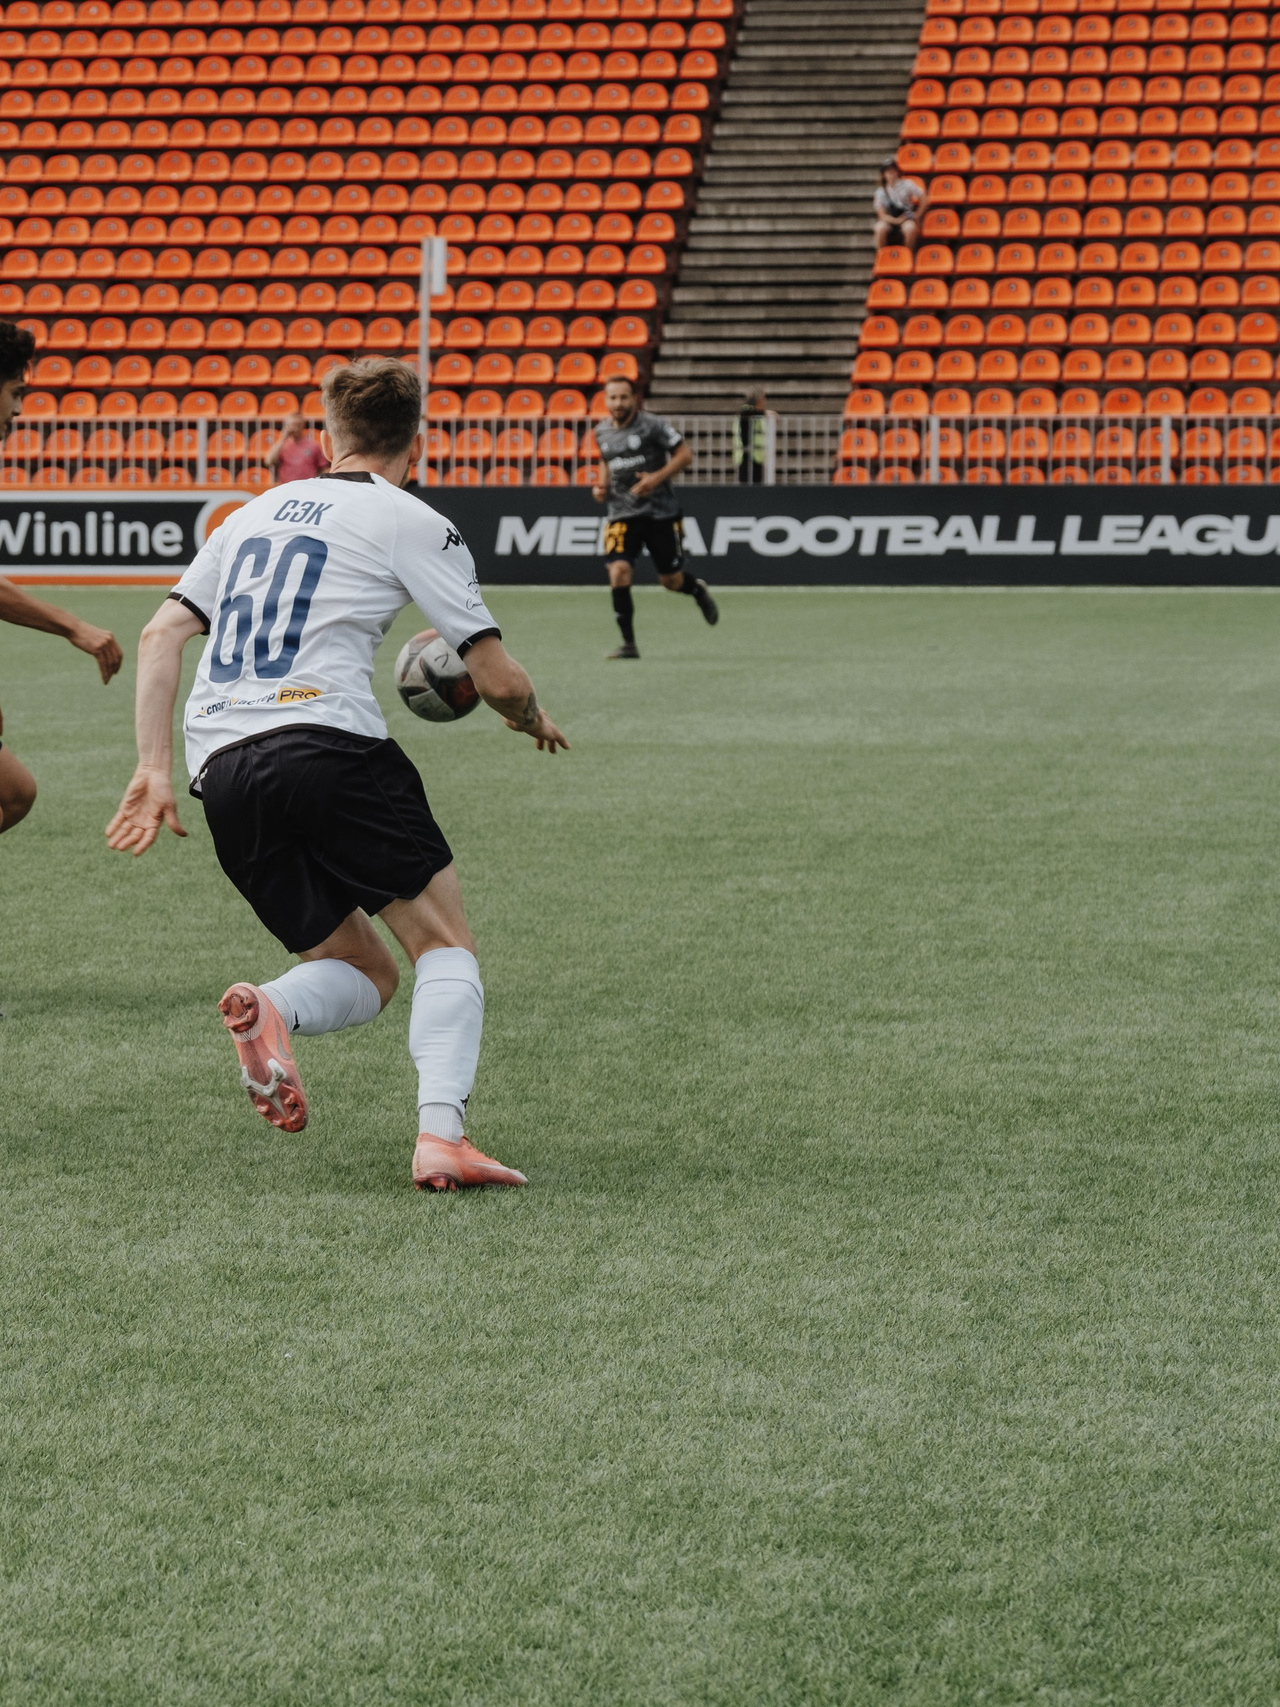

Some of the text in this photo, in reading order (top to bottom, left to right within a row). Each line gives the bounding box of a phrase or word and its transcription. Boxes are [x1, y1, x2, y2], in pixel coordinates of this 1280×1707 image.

[273, 499, 335, 526] СЭК
[495, 516, 708, 556] MEA
[710, 515, 1056, 556] FOOTBALL
[209, 535, 329, 684] 60
[280, 689, 318, 702] PRO
